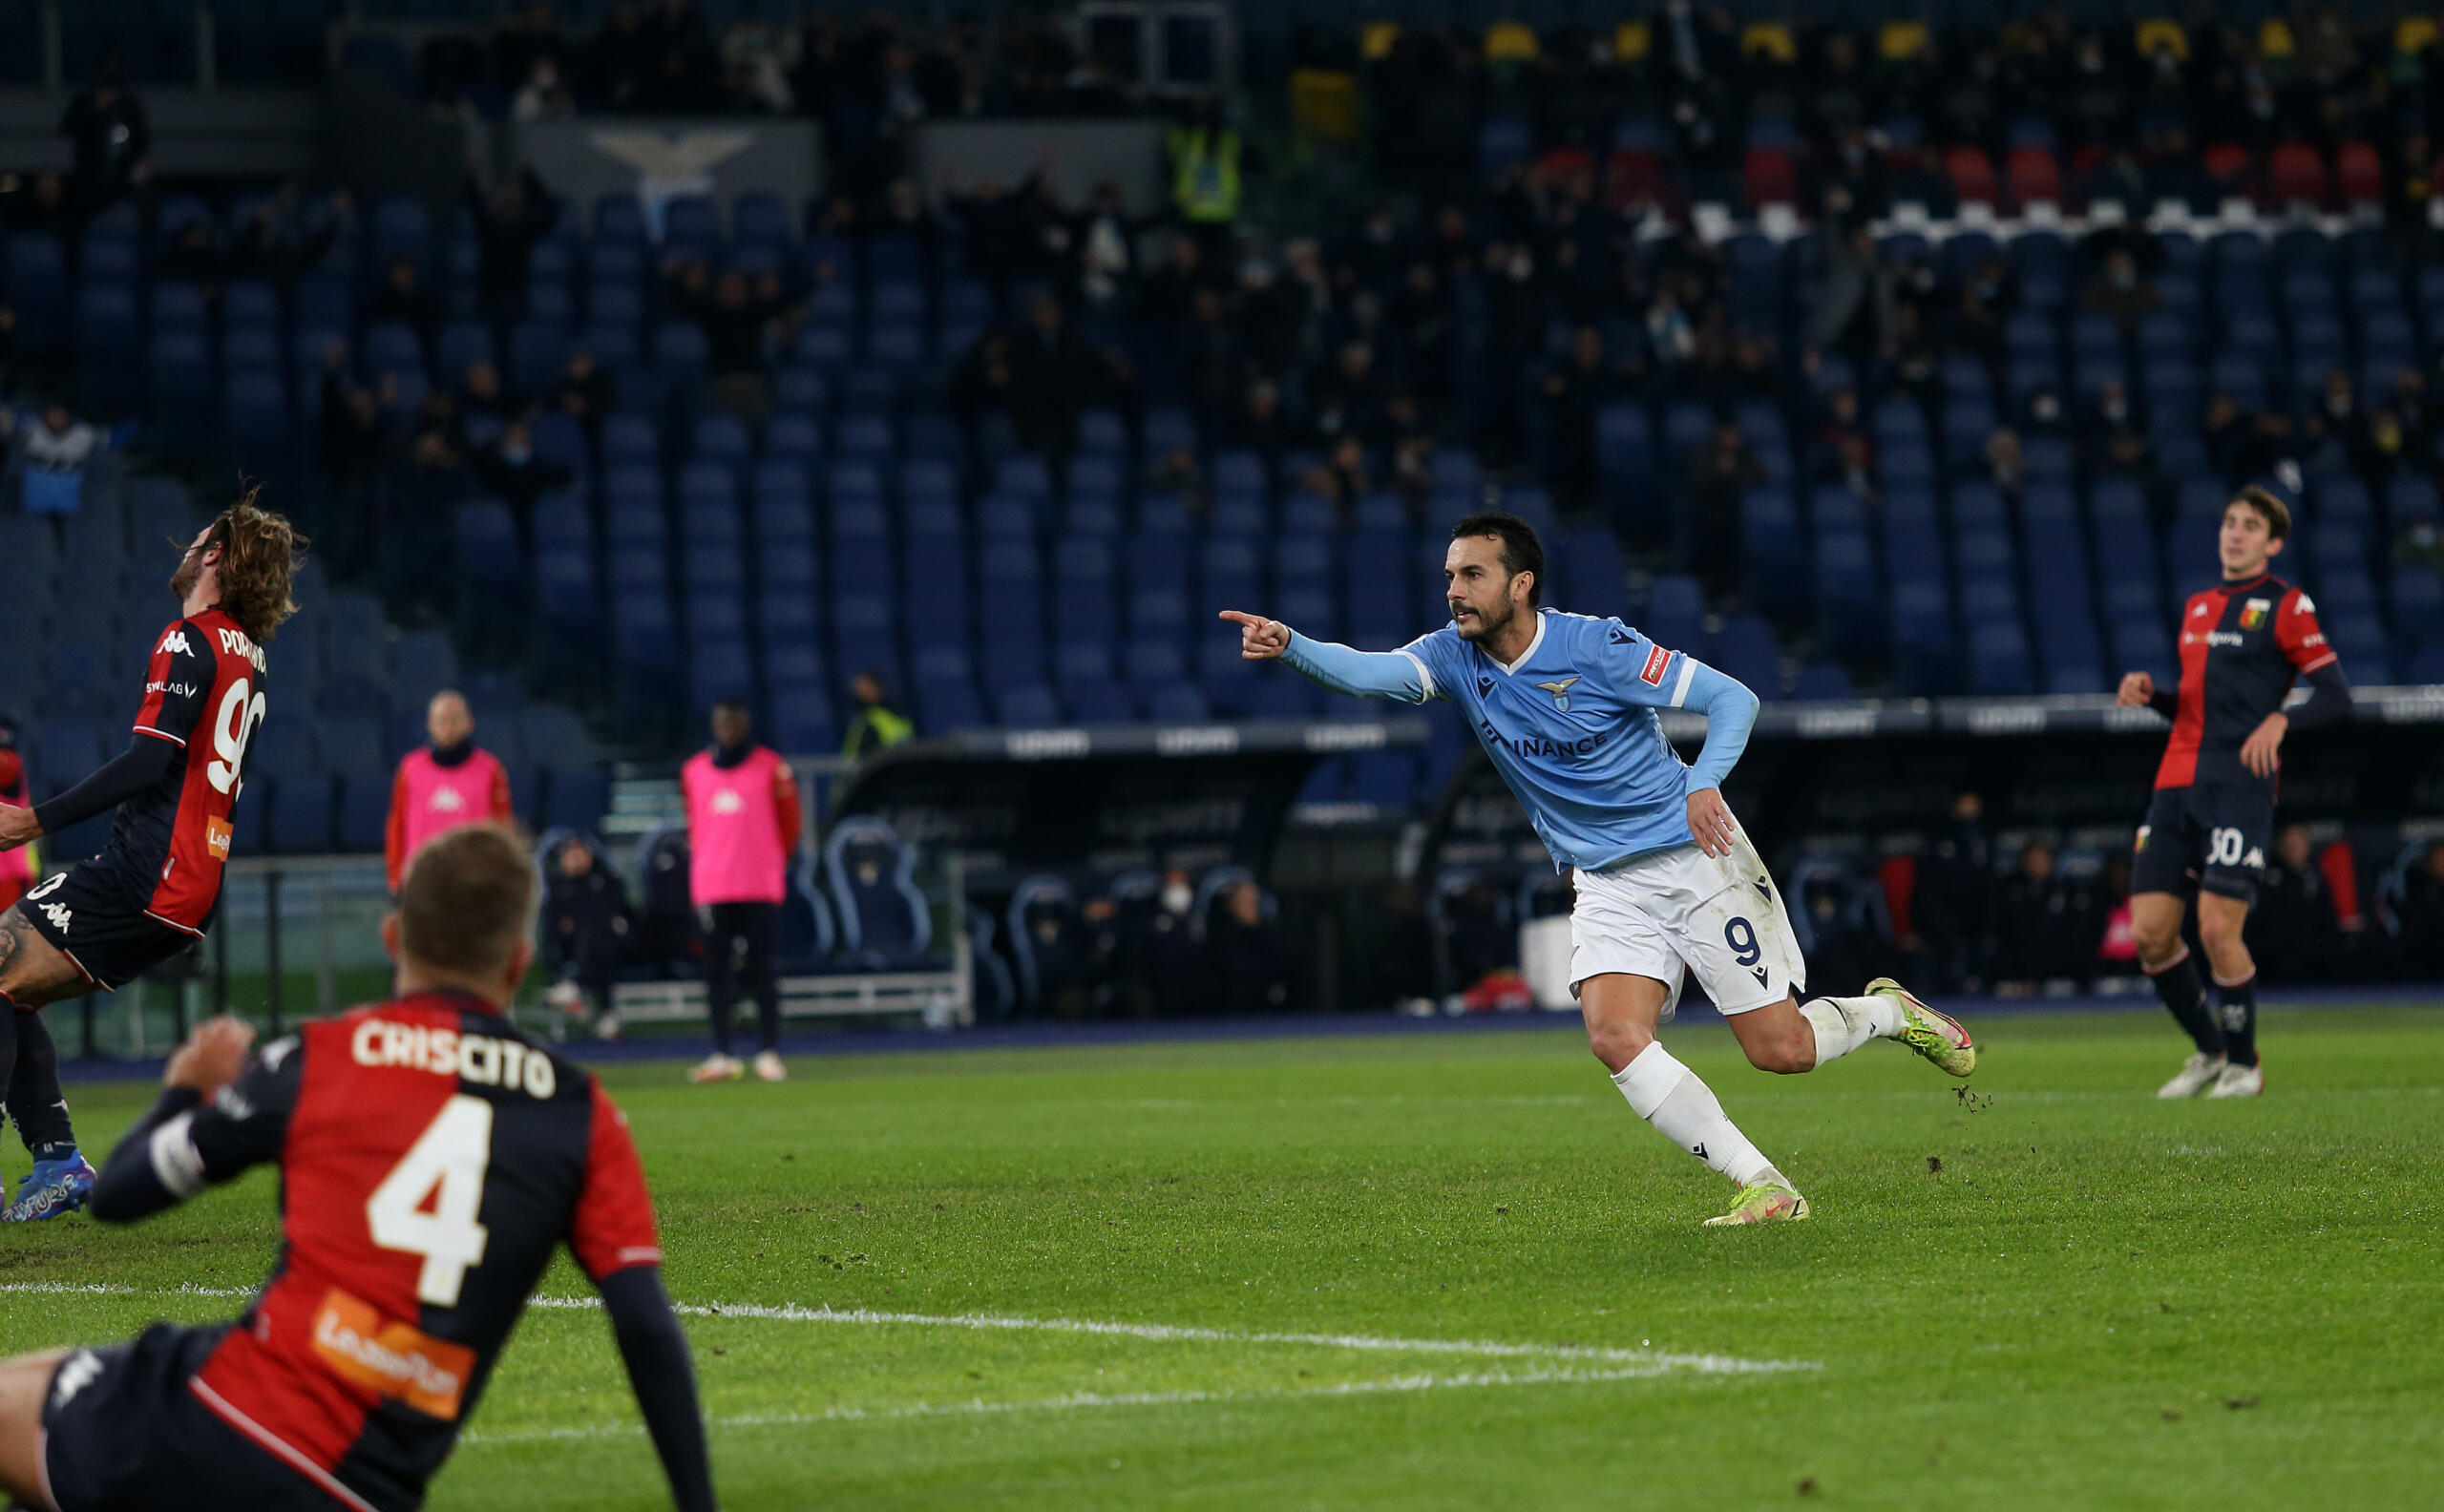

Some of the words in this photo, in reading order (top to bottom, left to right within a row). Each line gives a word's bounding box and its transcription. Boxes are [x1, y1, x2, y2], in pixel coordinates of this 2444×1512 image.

[1501, 730, 1608, 758] INANCE
[1724, 916, 1761, 967] 9
[351, 1018, 557, 1100] CRISCITO
[365, 1092, 495, 1309] 4
